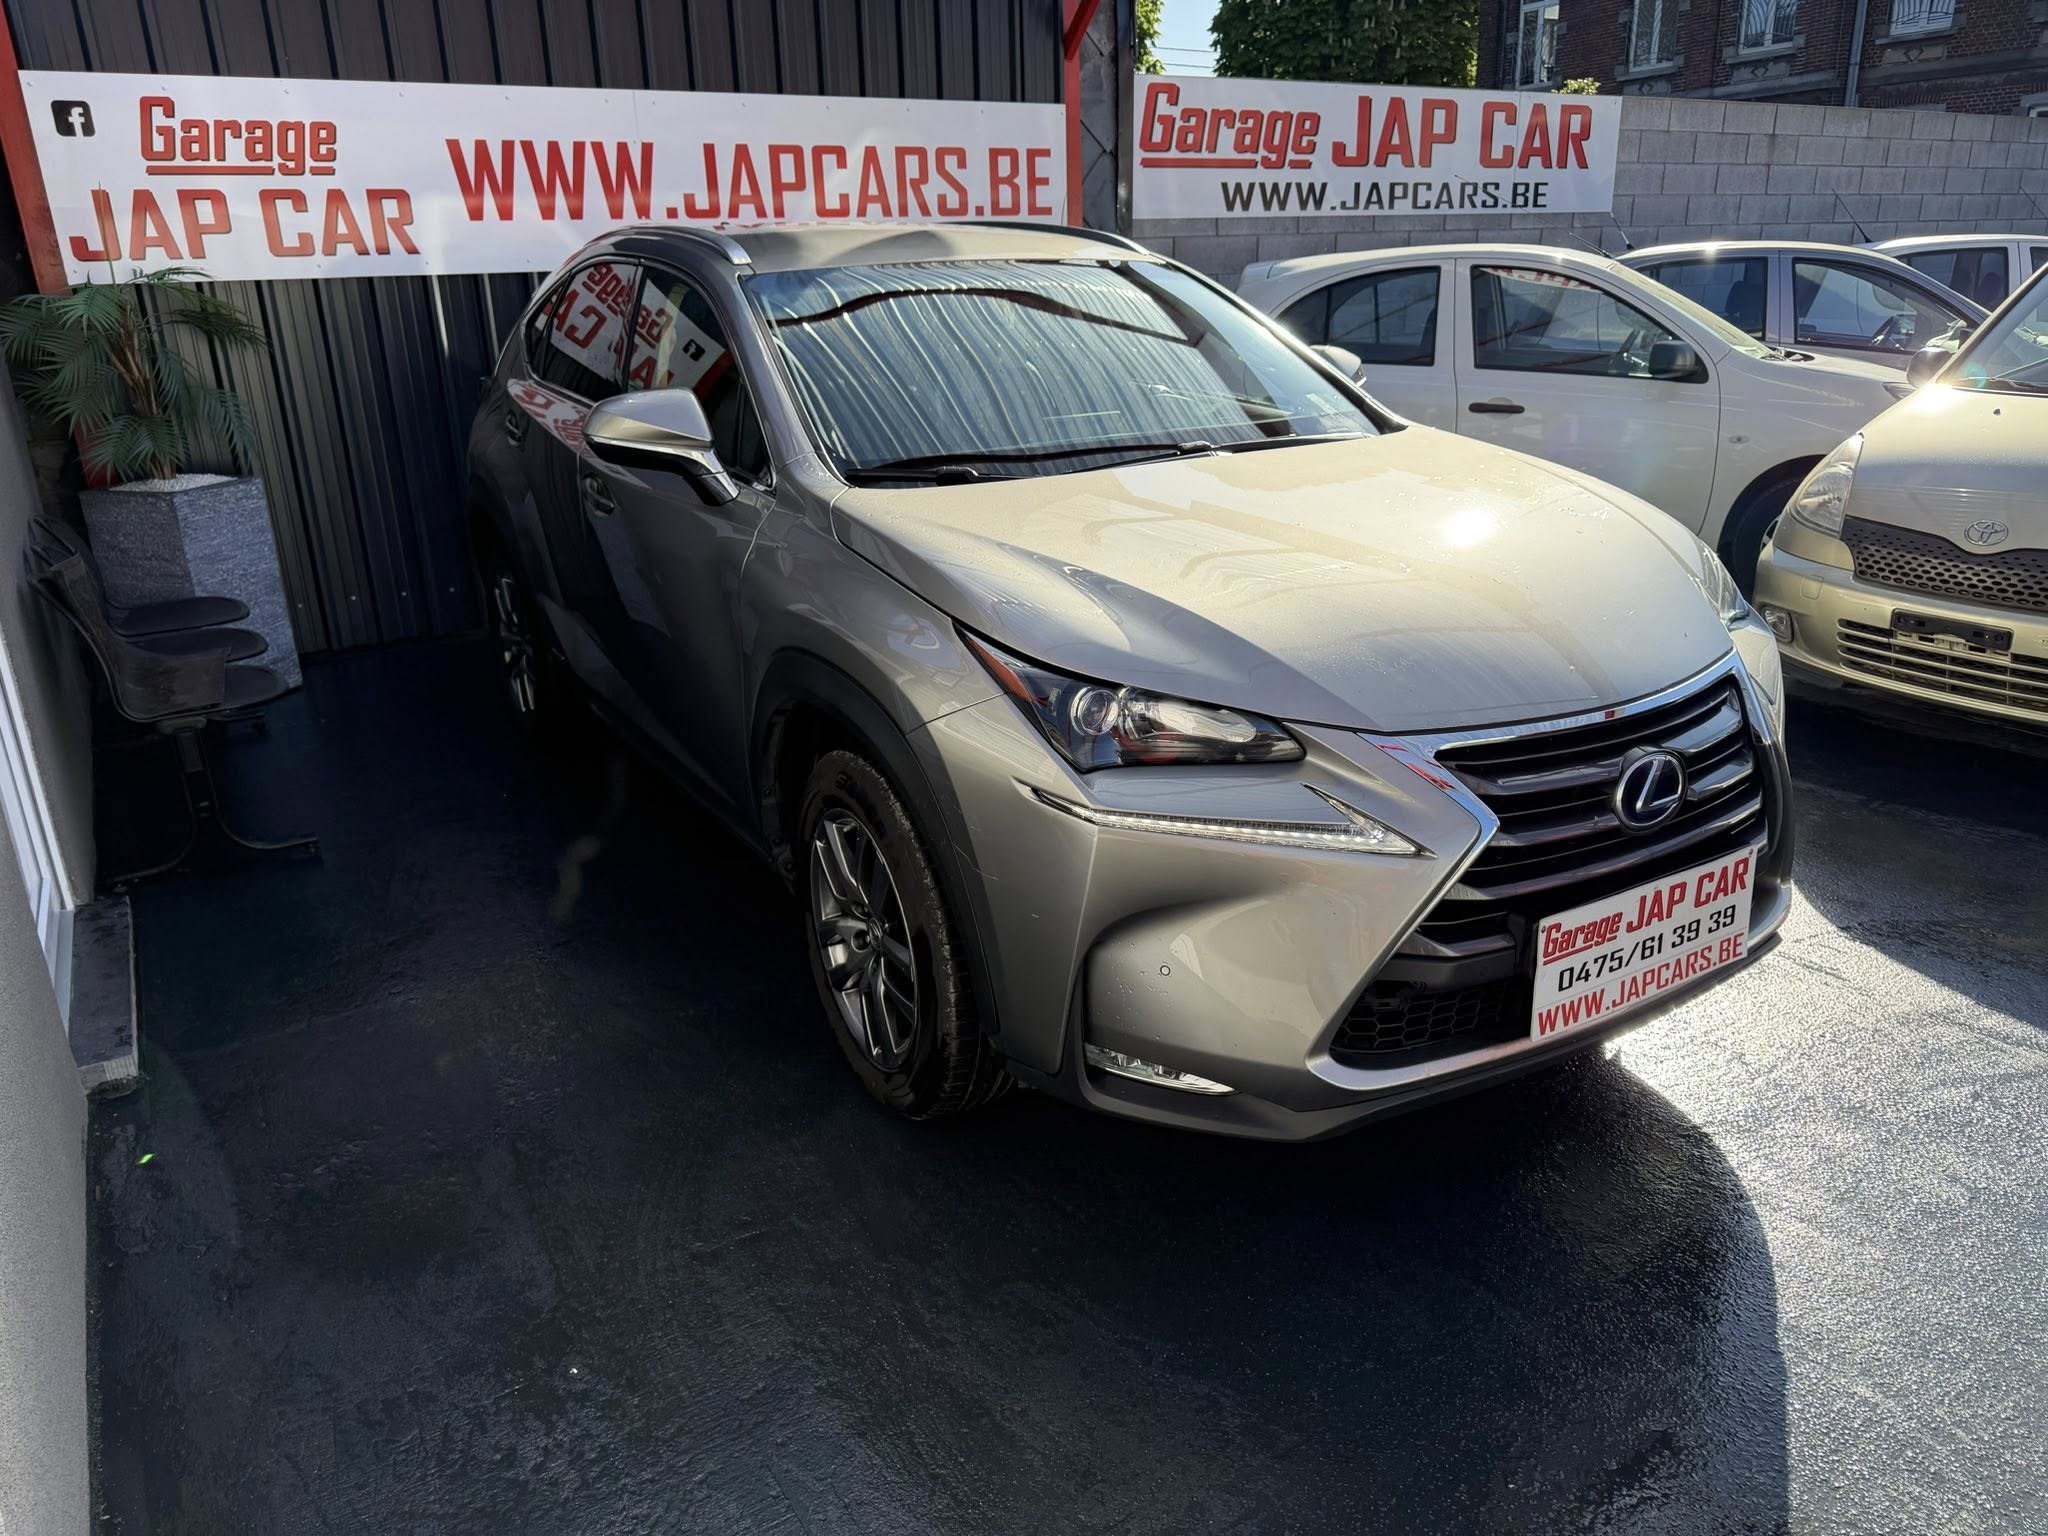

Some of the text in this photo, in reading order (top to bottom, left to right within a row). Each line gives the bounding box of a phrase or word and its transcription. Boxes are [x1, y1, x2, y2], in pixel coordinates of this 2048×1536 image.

[139, 95, 337, 176] Garage
[1139, 82, 1593, 169] Garage JAP CAR
[446, 138, 1053, 223] WWW.JAPCARS.BE
[1220, 181, 1549, 212] WWW.JAPCARS.BE
[69, 187, 420, 263] JAP CAR
[1542, 857, 1751, 960] Garage JAP CAR
[1557, 903, 1737, 993] 0475/61 39 39
[1537, 932, 1745, 1037] WWW.JAPCARS.BE
